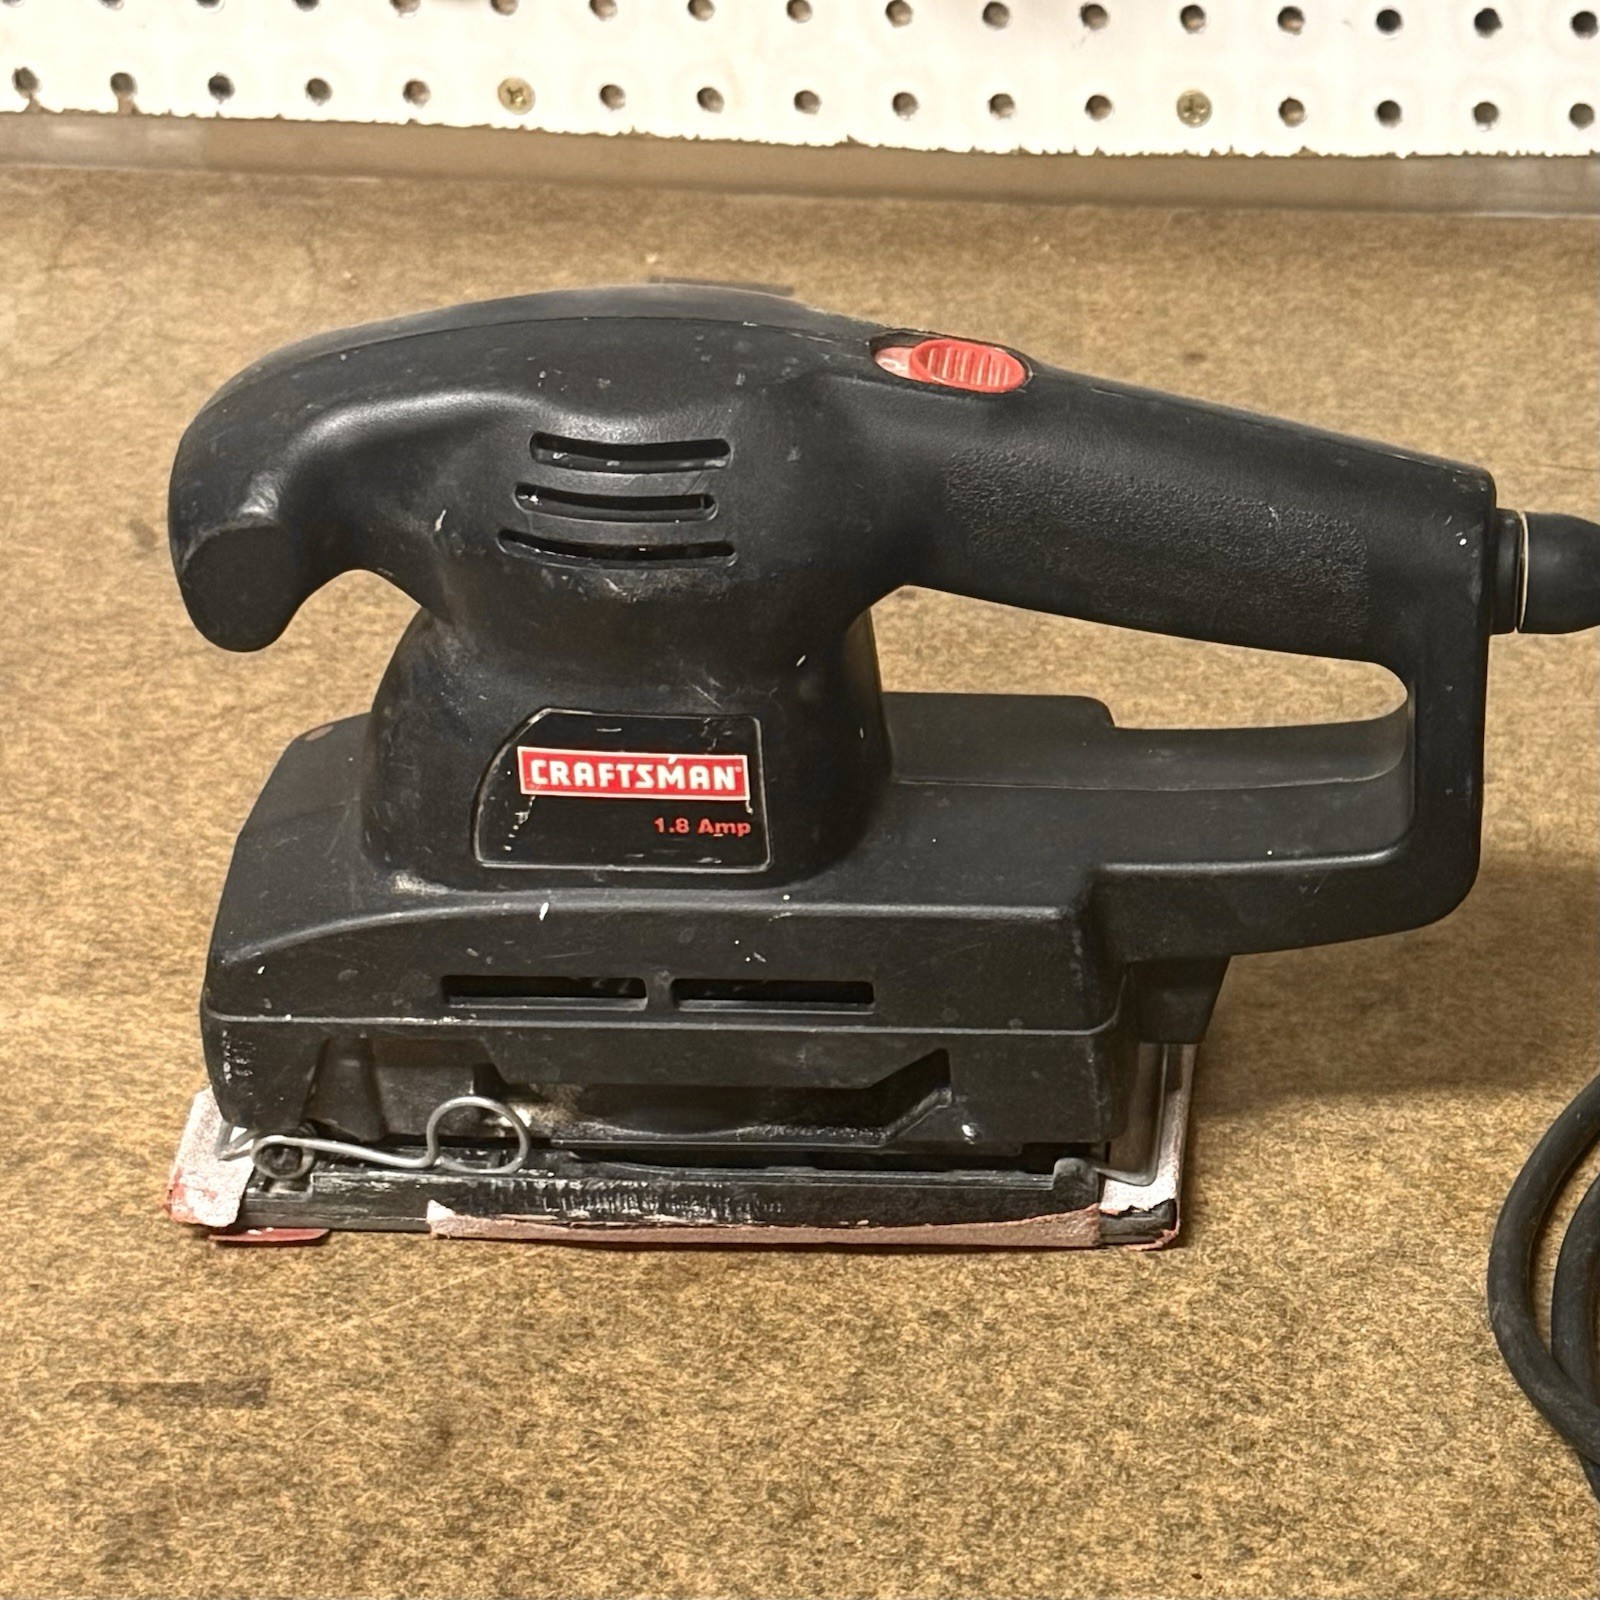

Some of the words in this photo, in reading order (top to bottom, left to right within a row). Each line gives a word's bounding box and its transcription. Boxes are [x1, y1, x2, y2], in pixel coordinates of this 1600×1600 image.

[529, 759, 737, 791] CRAFTSMAN
[654, 817, 690, 834] 1.8
[698, 818, 752, 837] Amp
